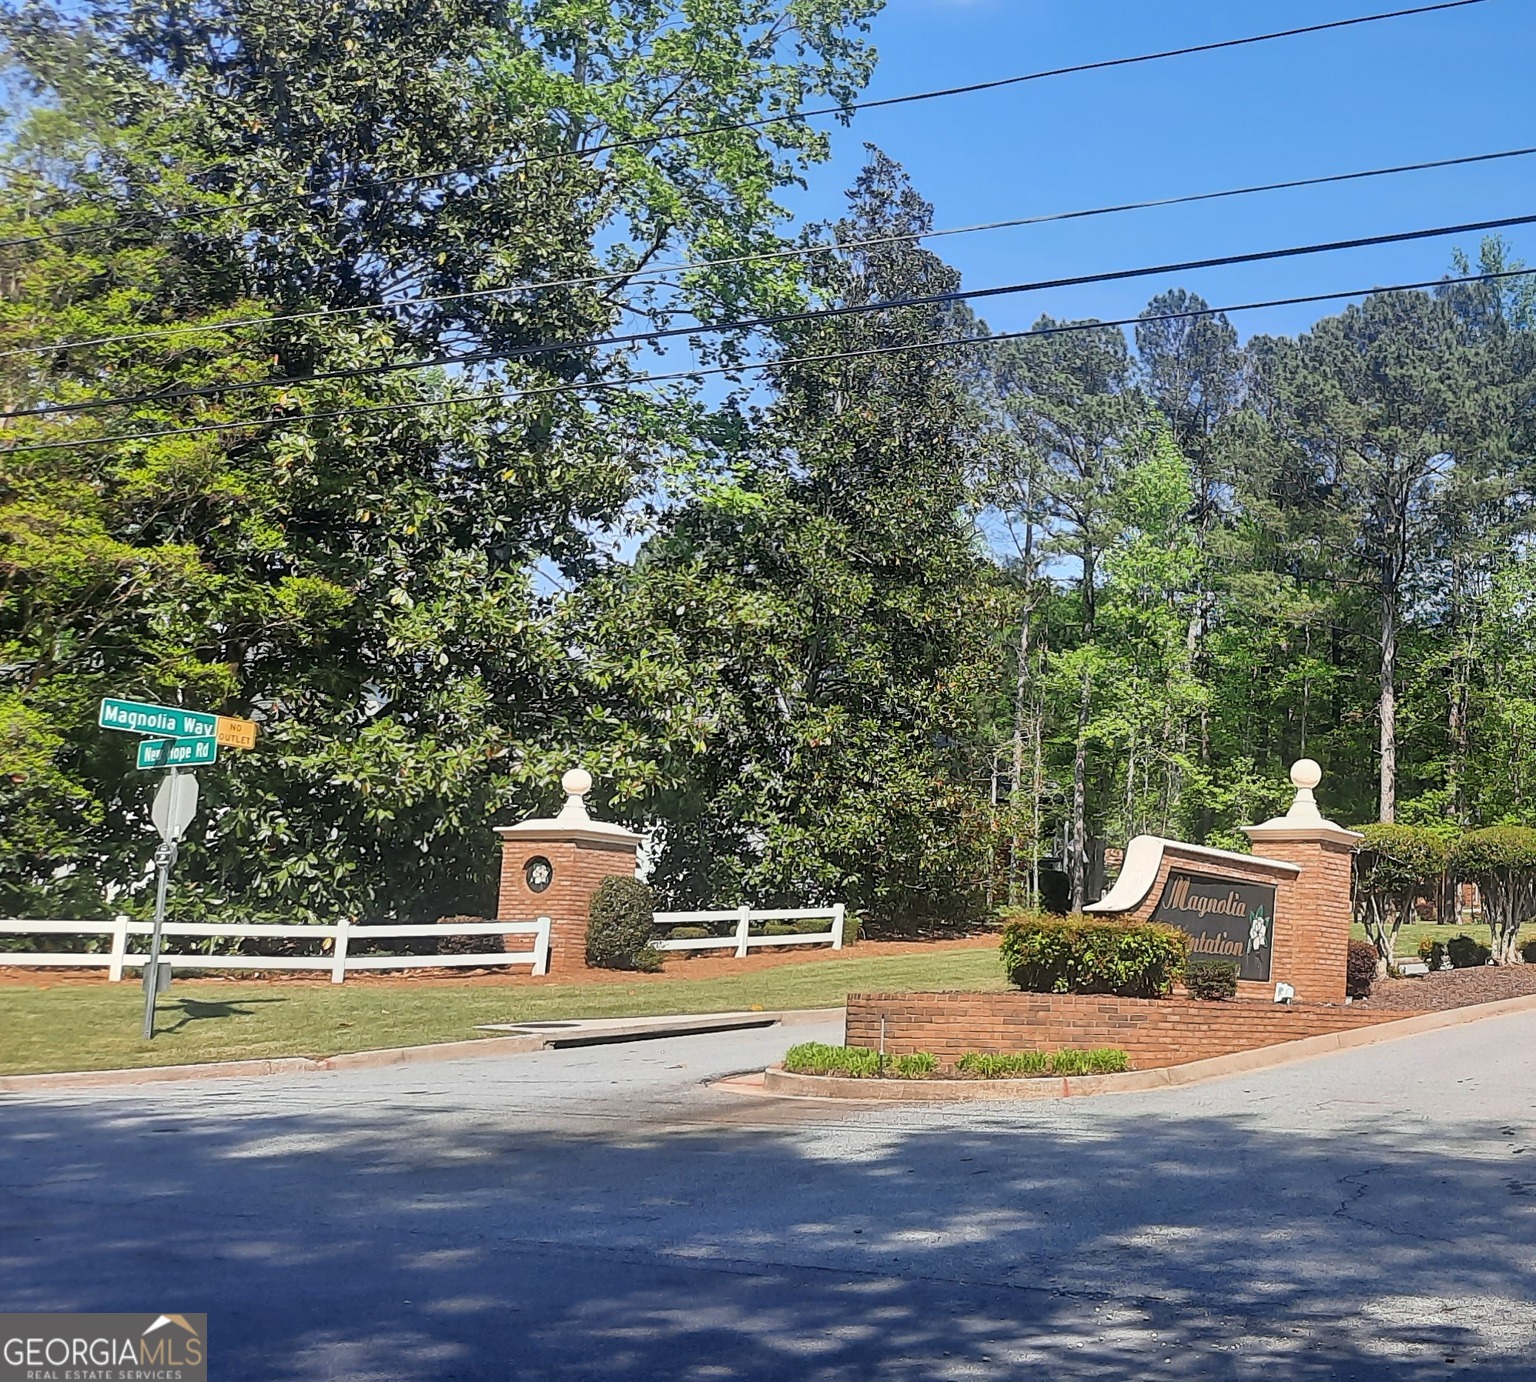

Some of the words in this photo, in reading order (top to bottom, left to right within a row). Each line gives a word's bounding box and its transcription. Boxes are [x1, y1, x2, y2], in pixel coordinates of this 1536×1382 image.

[104, 705, 176, 729] Magnolia
[184, 717, 214, 736] Way
[229, 723, 242, 732] NO
[218, 733, 250, 745] OUTLET
[195, 742, 210, 758] Rd
[1162, 875, 1247, 918] Magnolia
[1189, 931, 1244, 957] ntation
